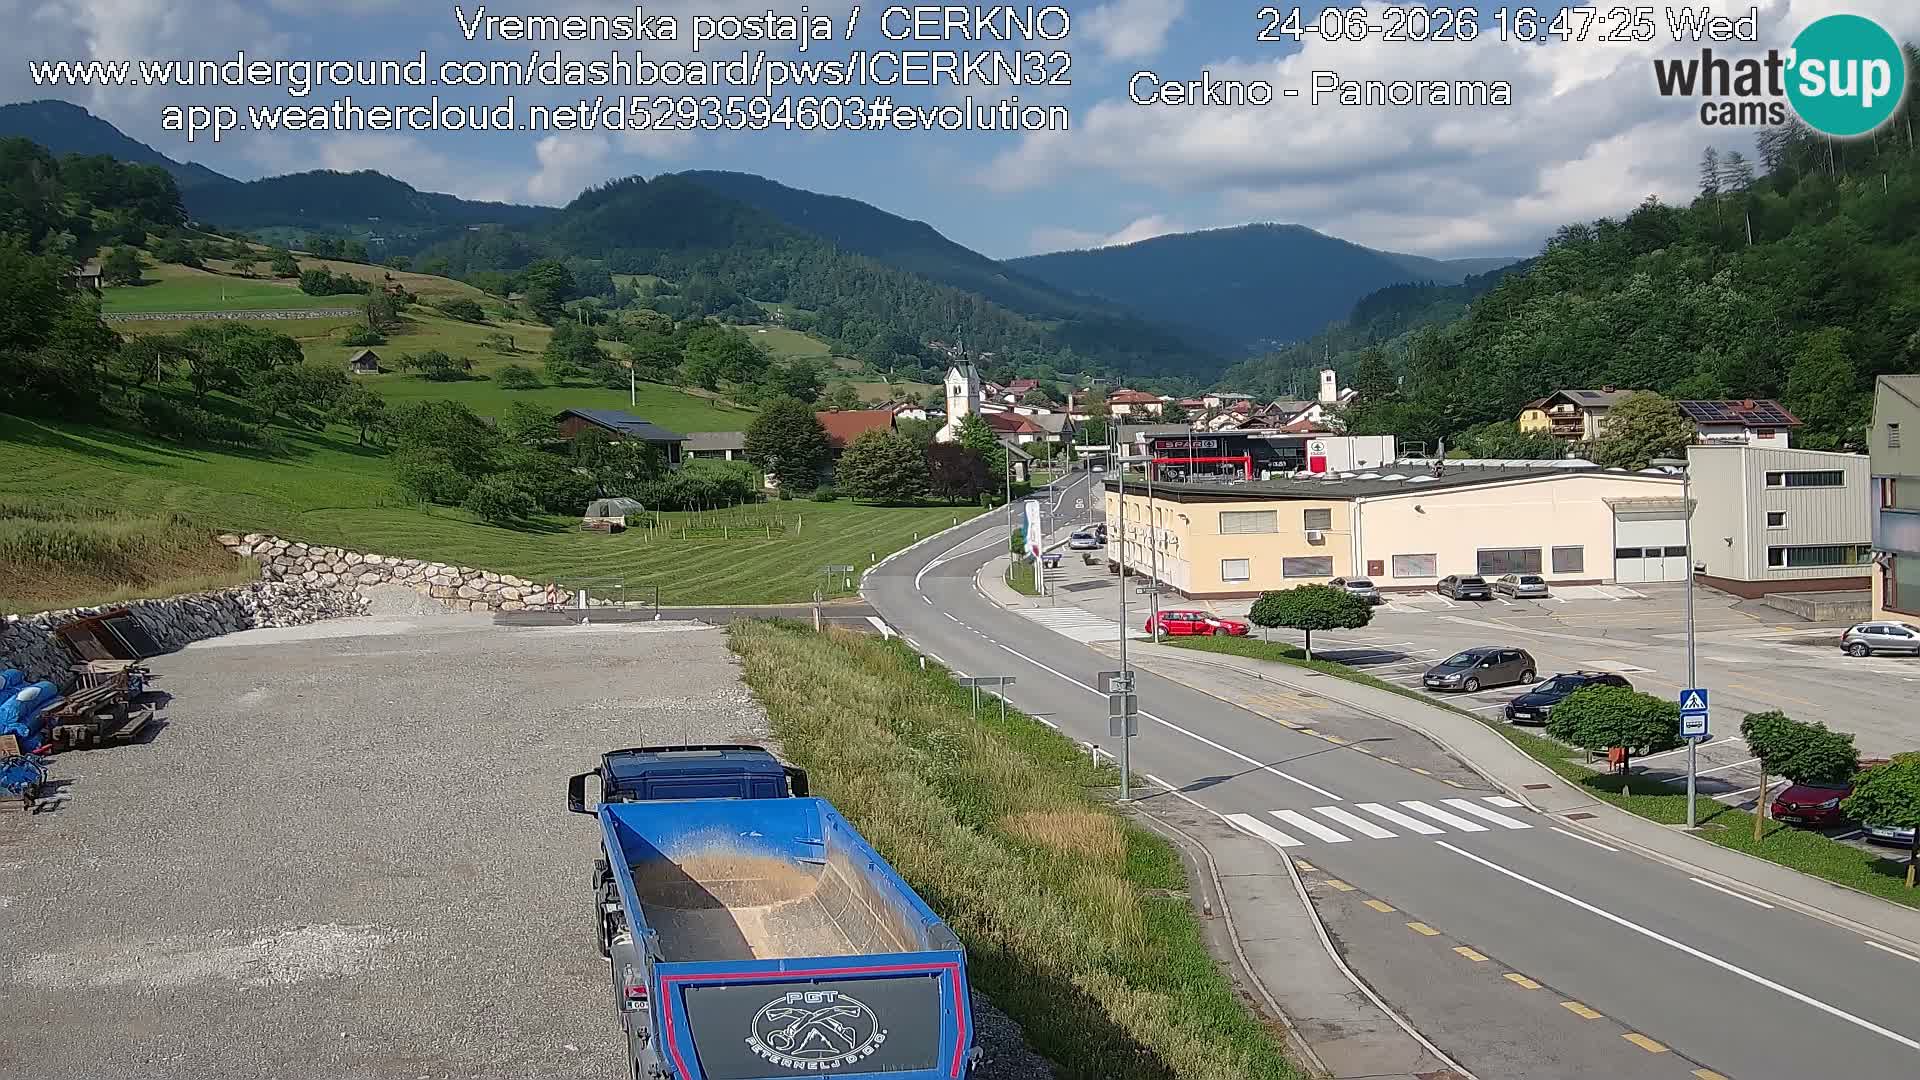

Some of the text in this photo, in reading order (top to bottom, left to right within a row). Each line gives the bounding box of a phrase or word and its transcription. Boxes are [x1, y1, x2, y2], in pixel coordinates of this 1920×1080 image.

[1165, 440, 1202, 449] SPAR
[786, 990, 839, 1005] PGT
[745, 1036, 841, 1070] PETERNELJ
